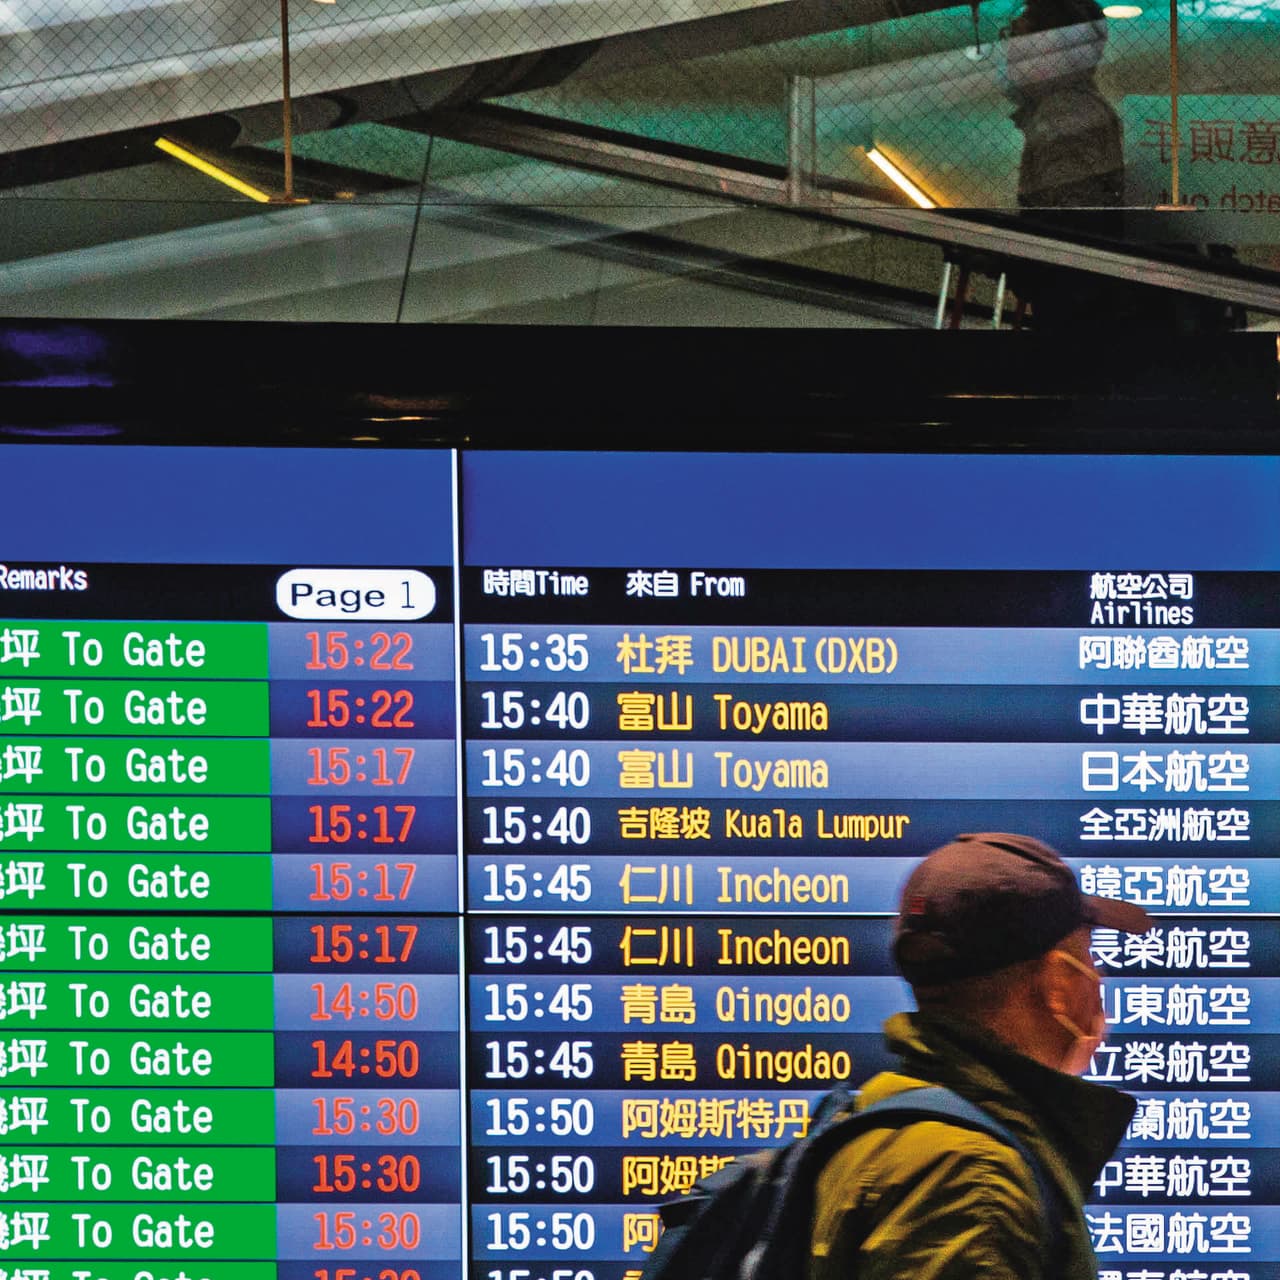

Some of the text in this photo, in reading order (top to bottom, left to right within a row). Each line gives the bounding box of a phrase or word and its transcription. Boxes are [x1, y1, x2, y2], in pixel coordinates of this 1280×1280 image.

[0, 564, 88, 591] Remarks
[291, 581, 415, 613] Page 1
[483, 568, 589, 597] 時間Time
[626, 569, 745, 598] 來自 From
[1089, 572, 1193, 600] 航空公司
[1090, 600, 1194, 625] Airlines
[62, 630, 414, 671] To Gate 15:22
[480, 632, 589, 672] 15:35
[616, 632, 694, 675] 杜拜
[712, 635, 899, 674] DUBAI(DXB)
[1079, 634, 1250, 670] 阿聯酋航空
[481, 690, 590, 729] 15:40
[616, 690, 693, 731] 富山
[713, 694, 828, 734] Toyama
[1080, 692, 1250, 736] 中華航空
[482, 748, 591, 787] 15:40
[617, 747, 694, 789] 富山
[713, 751, 829, 792] Toyama
[1081, 749, 1250, 793] 日本航空
[483, 806, 591, 844] 15:40
[617, 806, 711, 840] 吉隆坡
[725, 808, 803, 839] Kuala
[817, 809, 910, 842] Lumpur
[1079, 807, 1251, 842] 全亞洲航空
[483, 863, 592, 902] 15:45
[618, 863, 694, 905] 仁川
[716, 866, 849, 903] Incheon
[1080, 864, 1251, 907] 韓亞航空
[68, 981, 420, 1021] To Gate 14:50
[620, 982, 696, 1025] 青島
[715, 986, 851, 1026] Qingdao
[621, 1097, 812, 1139] 阿姆斯特丹
